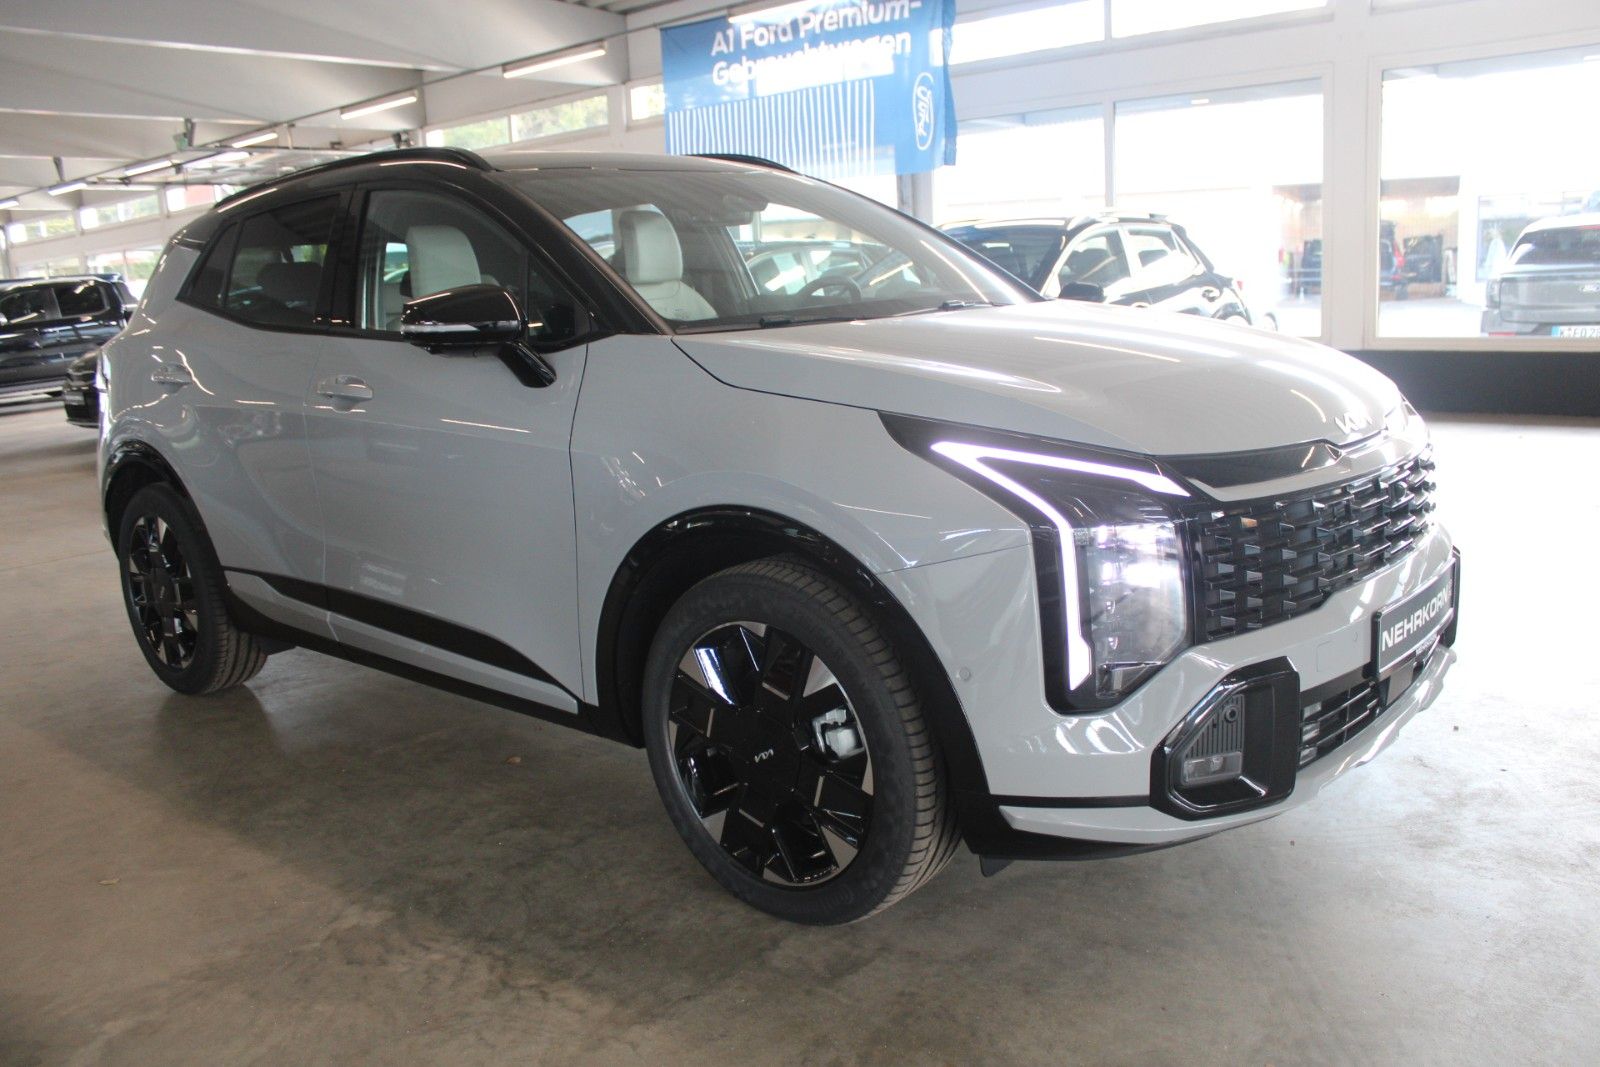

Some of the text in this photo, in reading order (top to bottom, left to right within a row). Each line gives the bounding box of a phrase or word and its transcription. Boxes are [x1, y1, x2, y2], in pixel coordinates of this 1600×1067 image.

[711, 28, 735, 56] A1
[740, 21, 794, 50] Ford
[1381, 586, 1449, 652] NEHRKORN
